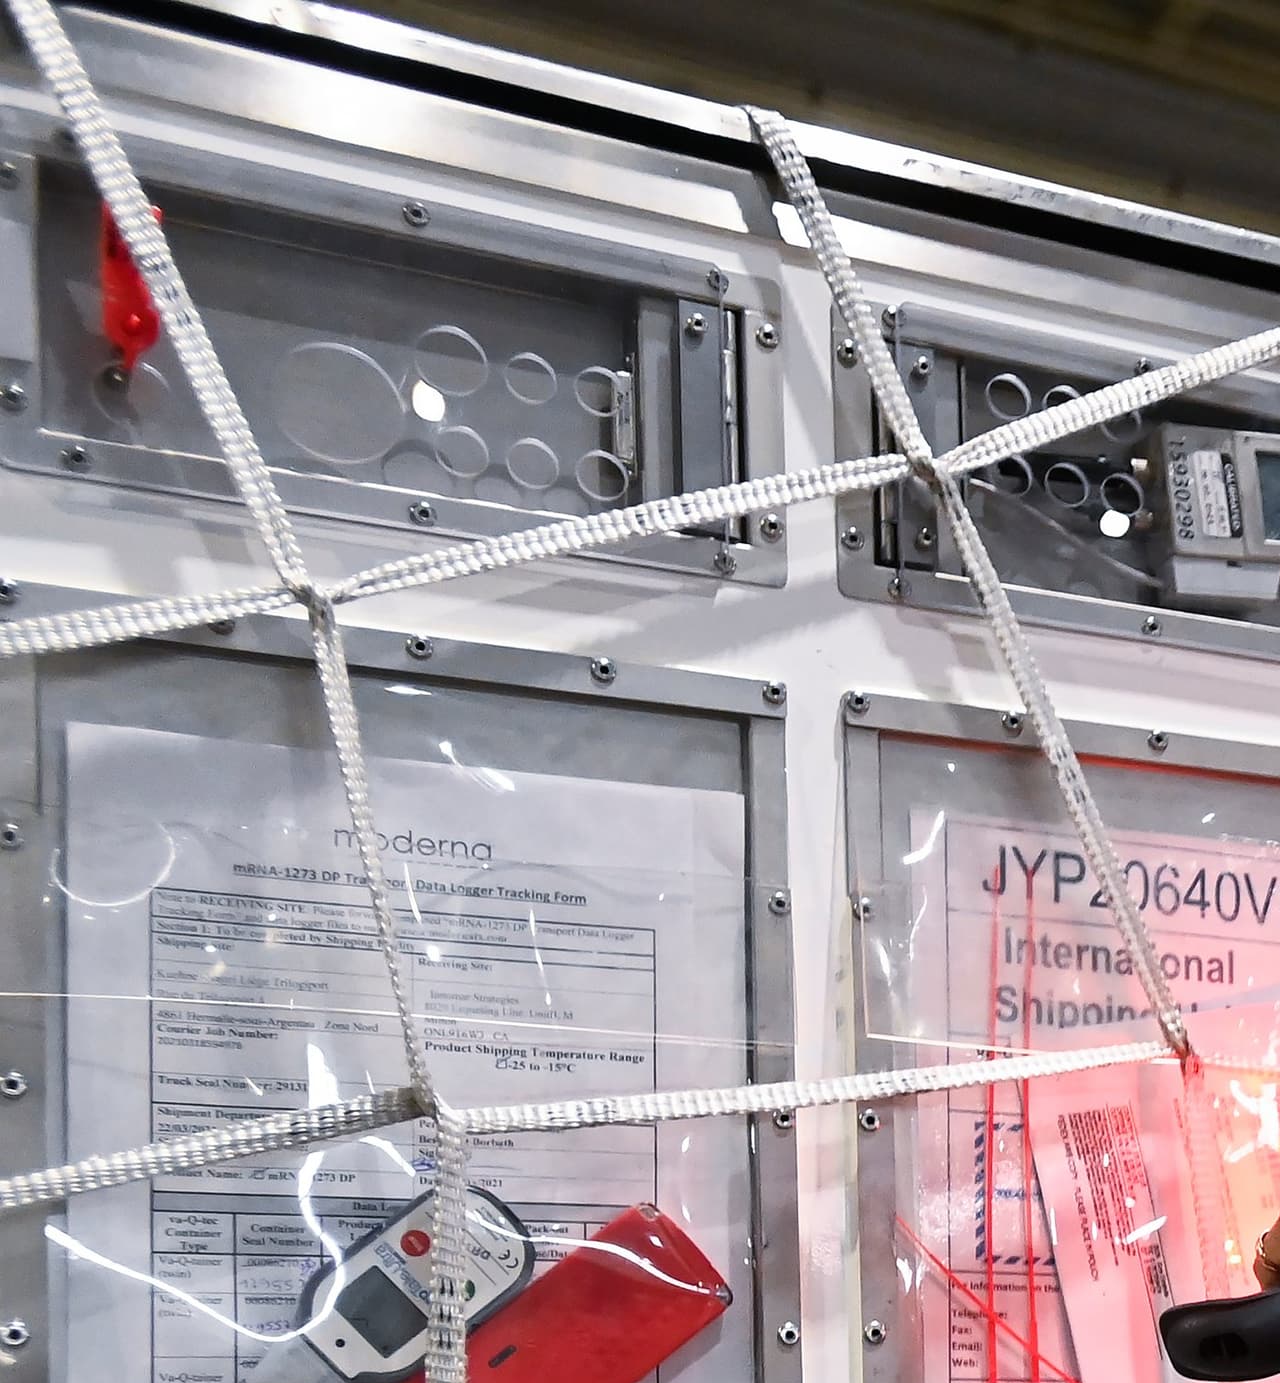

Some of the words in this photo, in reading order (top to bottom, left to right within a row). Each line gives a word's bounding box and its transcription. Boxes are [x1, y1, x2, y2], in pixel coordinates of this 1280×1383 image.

[233, 863, 317, 881] mRNA-1273
[322, 870, 341, 882] DP
[416, 879, 446, 892] Data
[450, 883, 494, 898] Logger
[497, 886, 550, 903] Tracking
[554, 891, 587, 905] Form
[1004, 927, 1234, 985] Internaonal
[995, 984, 1156, 1029] Shippin
[425, 1041, 472, 1054] Product
[475, 1044, 527, 1059] Shipping
[609, 1052, 645, 1064] Range
[970, 1282, 1027, 1293] Infomation
[952, 1309, 1008, 1321] Telephe:
[952, 1326, 973, 1335] Fax:
[952, 1342, 983, 1352] Email:
[952, 1358, 979, 1368] Web:
